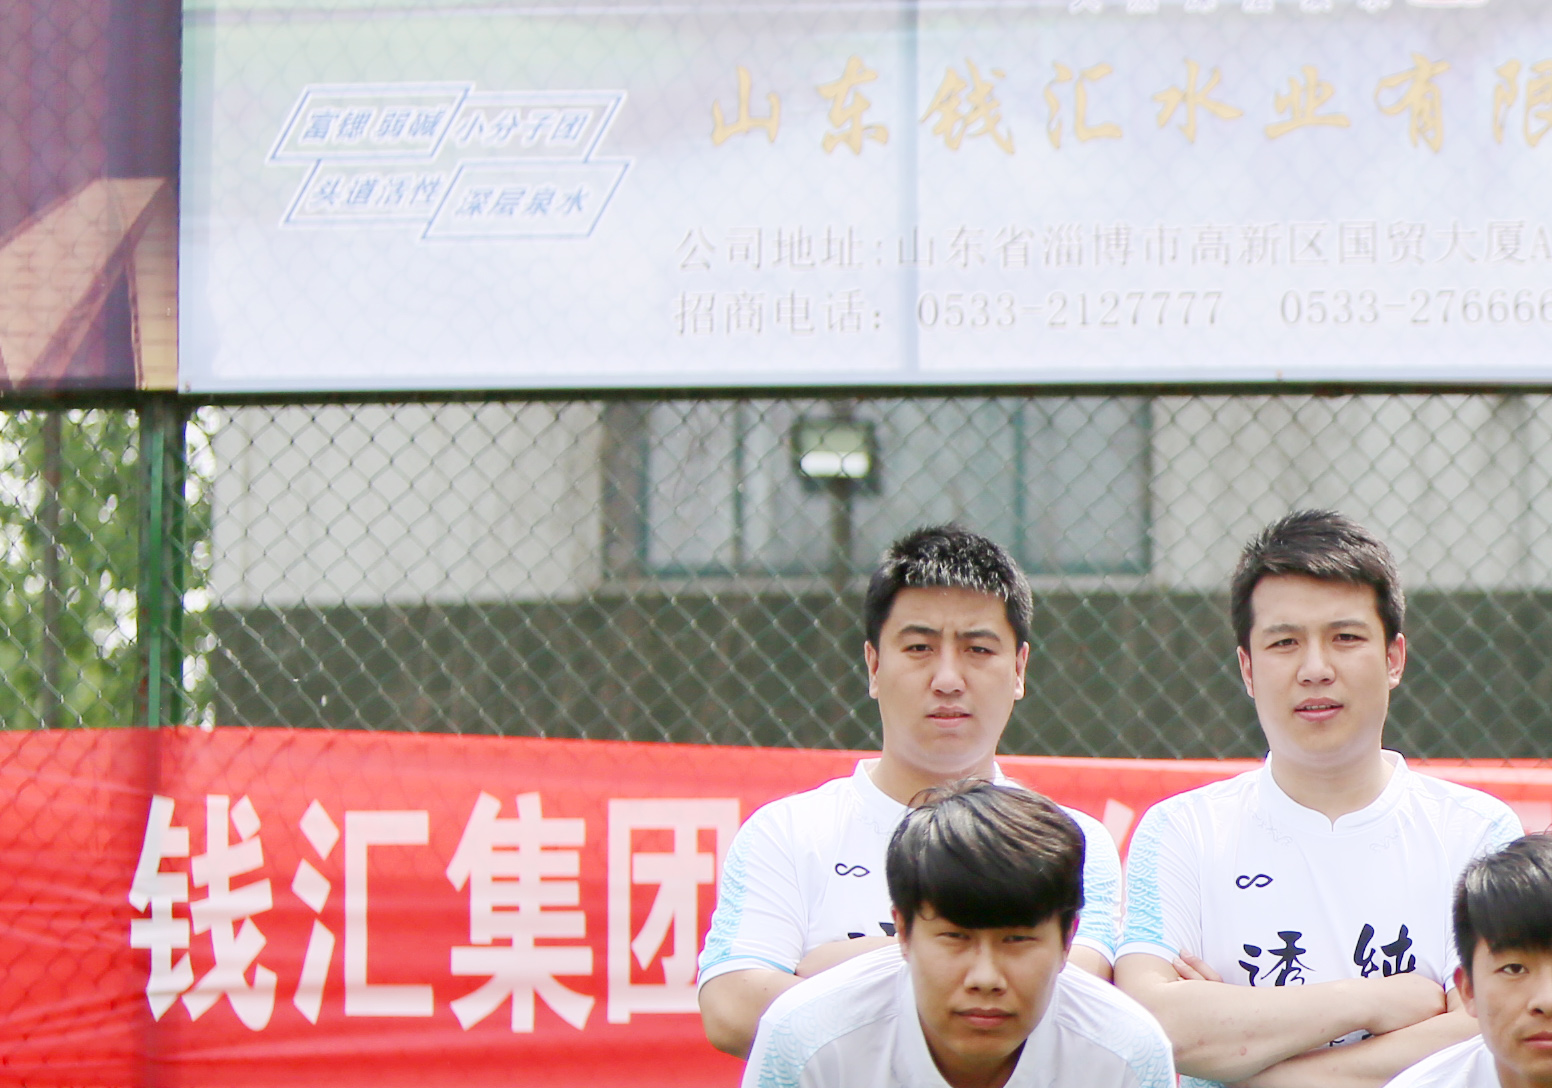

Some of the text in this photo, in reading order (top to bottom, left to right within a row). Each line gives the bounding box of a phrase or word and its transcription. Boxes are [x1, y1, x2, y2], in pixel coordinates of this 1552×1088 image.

[459, 113, 587, 142] 小分子团
[458, 188, 589, 215] 深层泉水
[917, 290, 1222, 331] 0533-2127777
[130, 792, 742, 1032] 钱汇集团
